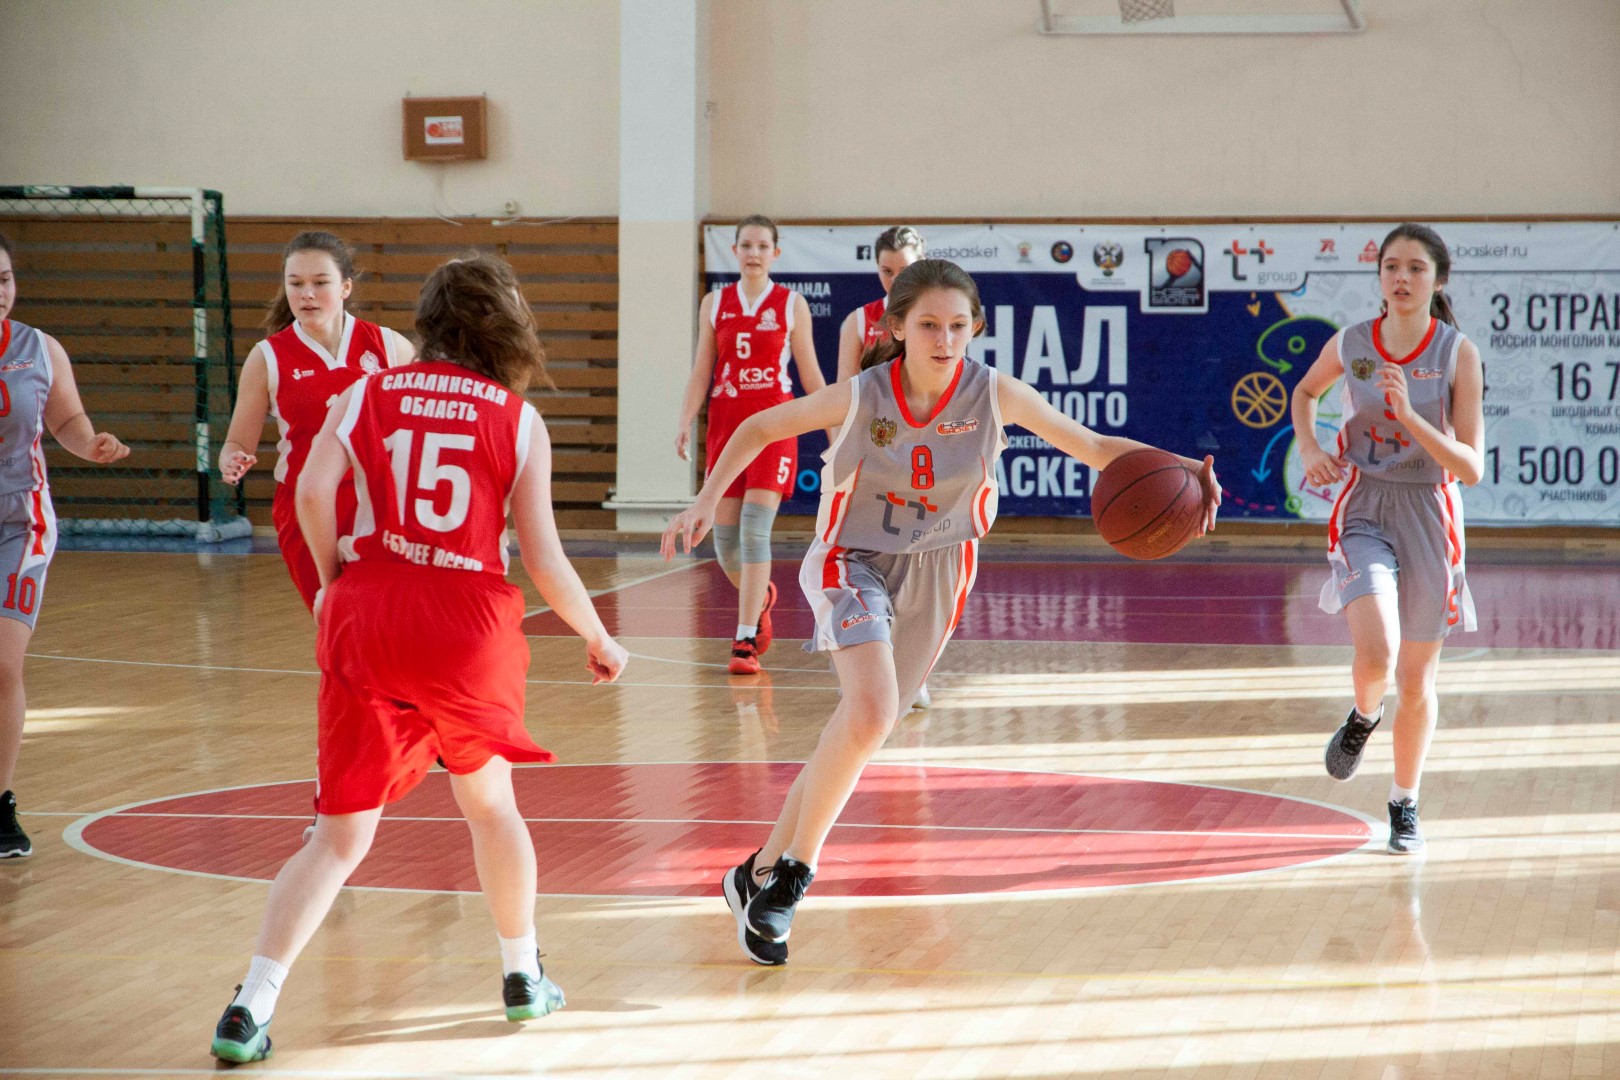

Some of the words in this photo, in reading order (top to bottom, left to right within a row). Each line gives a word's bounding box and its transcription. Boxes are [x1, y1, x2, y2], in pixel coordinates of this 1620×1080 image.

[1258, 270, 1297, 284] group
[1491, 293, 1511, 331] 3
[736, 332, 751, 359] 5
[1491, 334, 1537, 347] РОССИЯ
[1541, 334, 1605, 348] МОНГОЛИЯ
[381, 372, 508, 406] САХАЛИНСКАЯ
[739, 367, 775, 383] КЭС
[1551, 361, 1592, 401] 16
[400, 395, 478, 422] ОБЛАСТЬ
[1552, 405, 1612, 417] ШКОЛЬНЫХ
[1008, 435, 1056, 448] СКЕТБО
[777, 456, 792, 485] 5
[911, 445, 935, 490] 8
[1487, 446, 1500, 485] 1
[1518, 446, 1585, 485] 500
[1599, 446, 1619, 485] 0
[383, 429, 476, 533] 15
[1541, 490, 1608, 502] УЧАСТНИКОВ
[3, 572, 37, 616] 10
